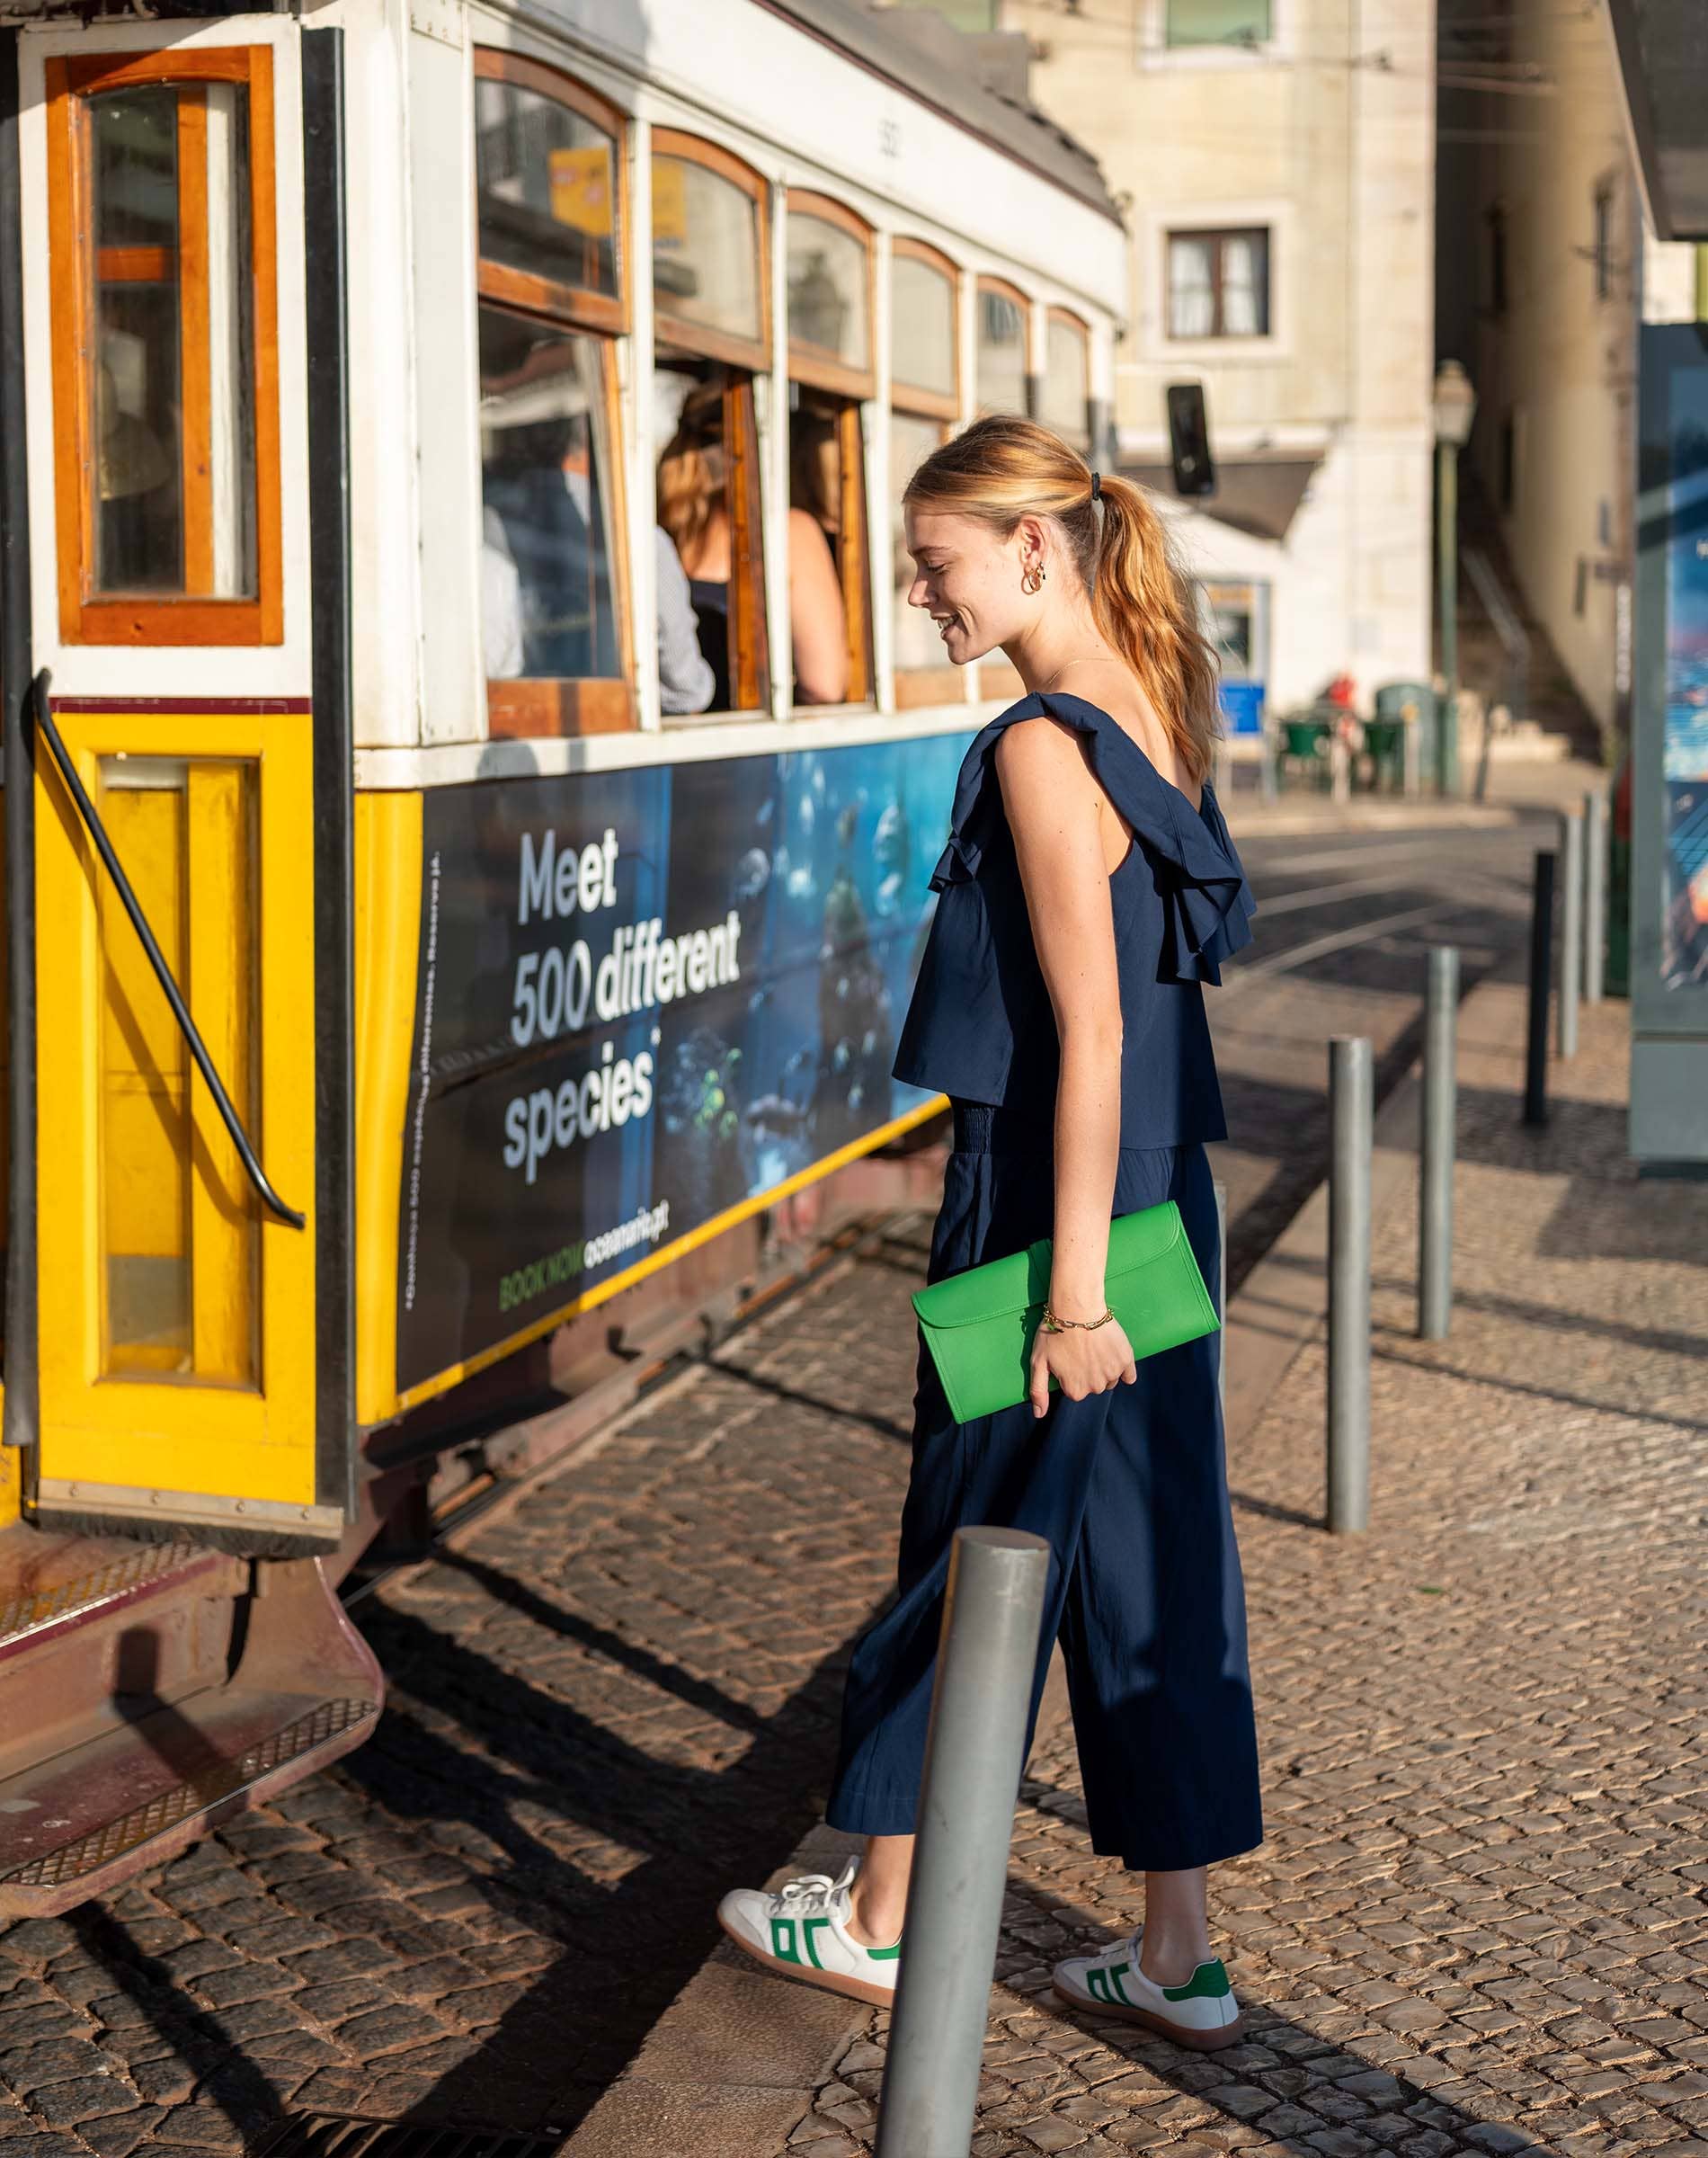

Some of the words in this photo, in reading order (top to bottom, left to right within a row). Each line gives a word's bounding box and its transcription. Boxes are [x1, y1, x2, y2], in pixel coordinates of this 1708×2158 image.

[518, 827, 618, 925] Meet
[511, 939, 592, 1048] 500
[595, 909, 742, 1022] different
[409, 1168, 420, 1208] 500
[499, 1261, 547, 1311] BOOK
[547, 1240, 584, 1284] NOW
